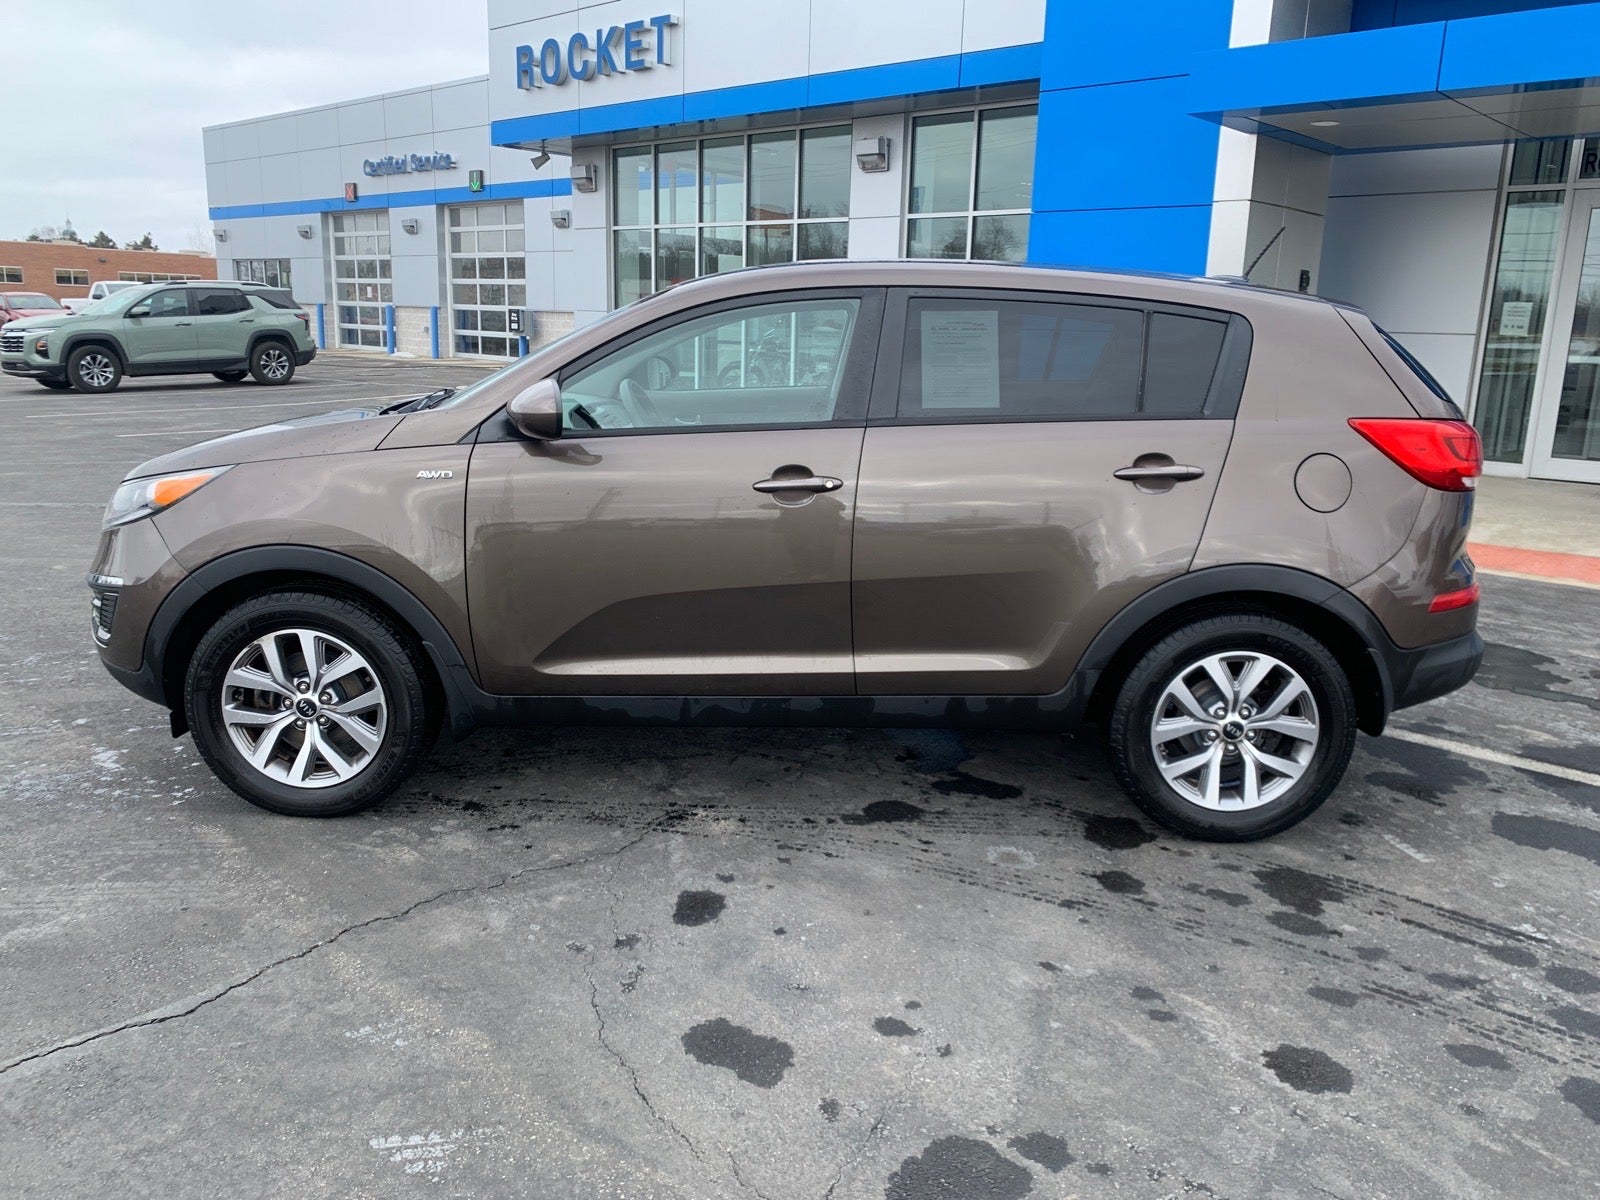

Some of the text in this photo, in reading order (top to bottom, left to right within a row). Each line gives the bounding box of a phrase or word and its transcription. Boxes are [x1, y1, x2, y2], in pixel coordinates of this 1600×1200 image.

[516, 14, 675, 90] ROCKET
[364, 151, 452, 176] Certified Service
[1584, 153, 1600, 173] R
[416, 470, 453, 479] AWD
[299, 700, 314, 716] KIA
[1226, 723, 1242, 737] KIA
